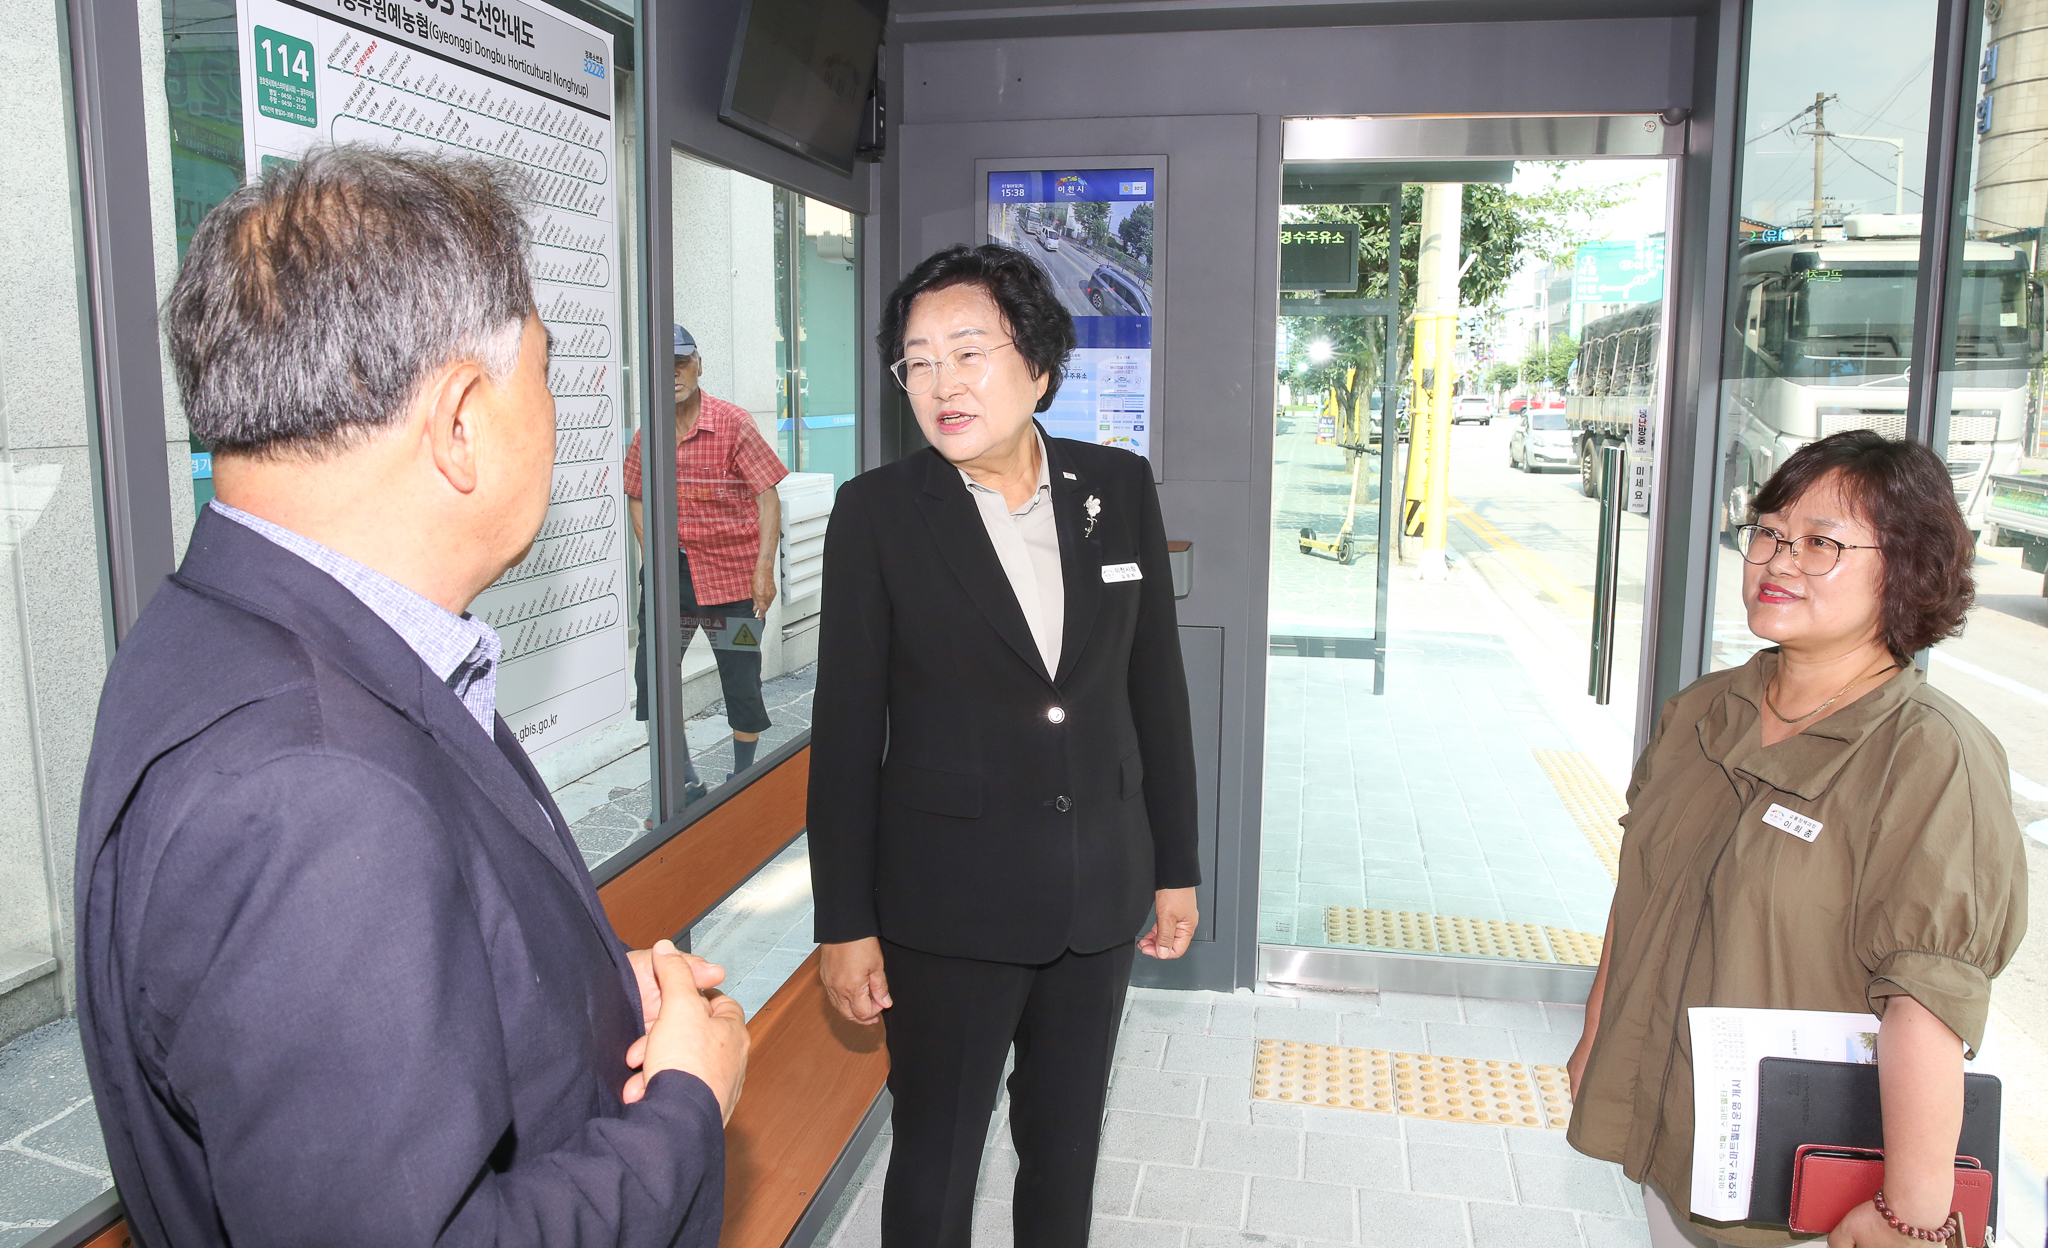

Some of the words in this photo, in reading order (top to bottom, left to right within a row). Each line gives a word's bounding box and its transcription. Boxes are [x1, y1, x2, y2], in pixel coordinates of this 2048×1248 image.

[461, 0, 536, 49] 노선안내도
[260, 38, 310, 83] 114
[474, 40, 506, 66] Dongbu
[507, 53, 552, 83] Horticultural
[553, 71, 589, 99] Nonghyup)
[583, 58, 605, 80] 32228
[1001, 188, 1025, 197] 15:38
[1057, 185, 1085, 194] 이천시
[1280, 231, 1345, 245] 경수주유소
[1634, 466, 1645, 500] 미세요
[1731, 1079, 1742, 1098] 개시
[1731, 1101, 1742, 1120] 운영
[1728, 1171, 1738, 1199] 장호원
